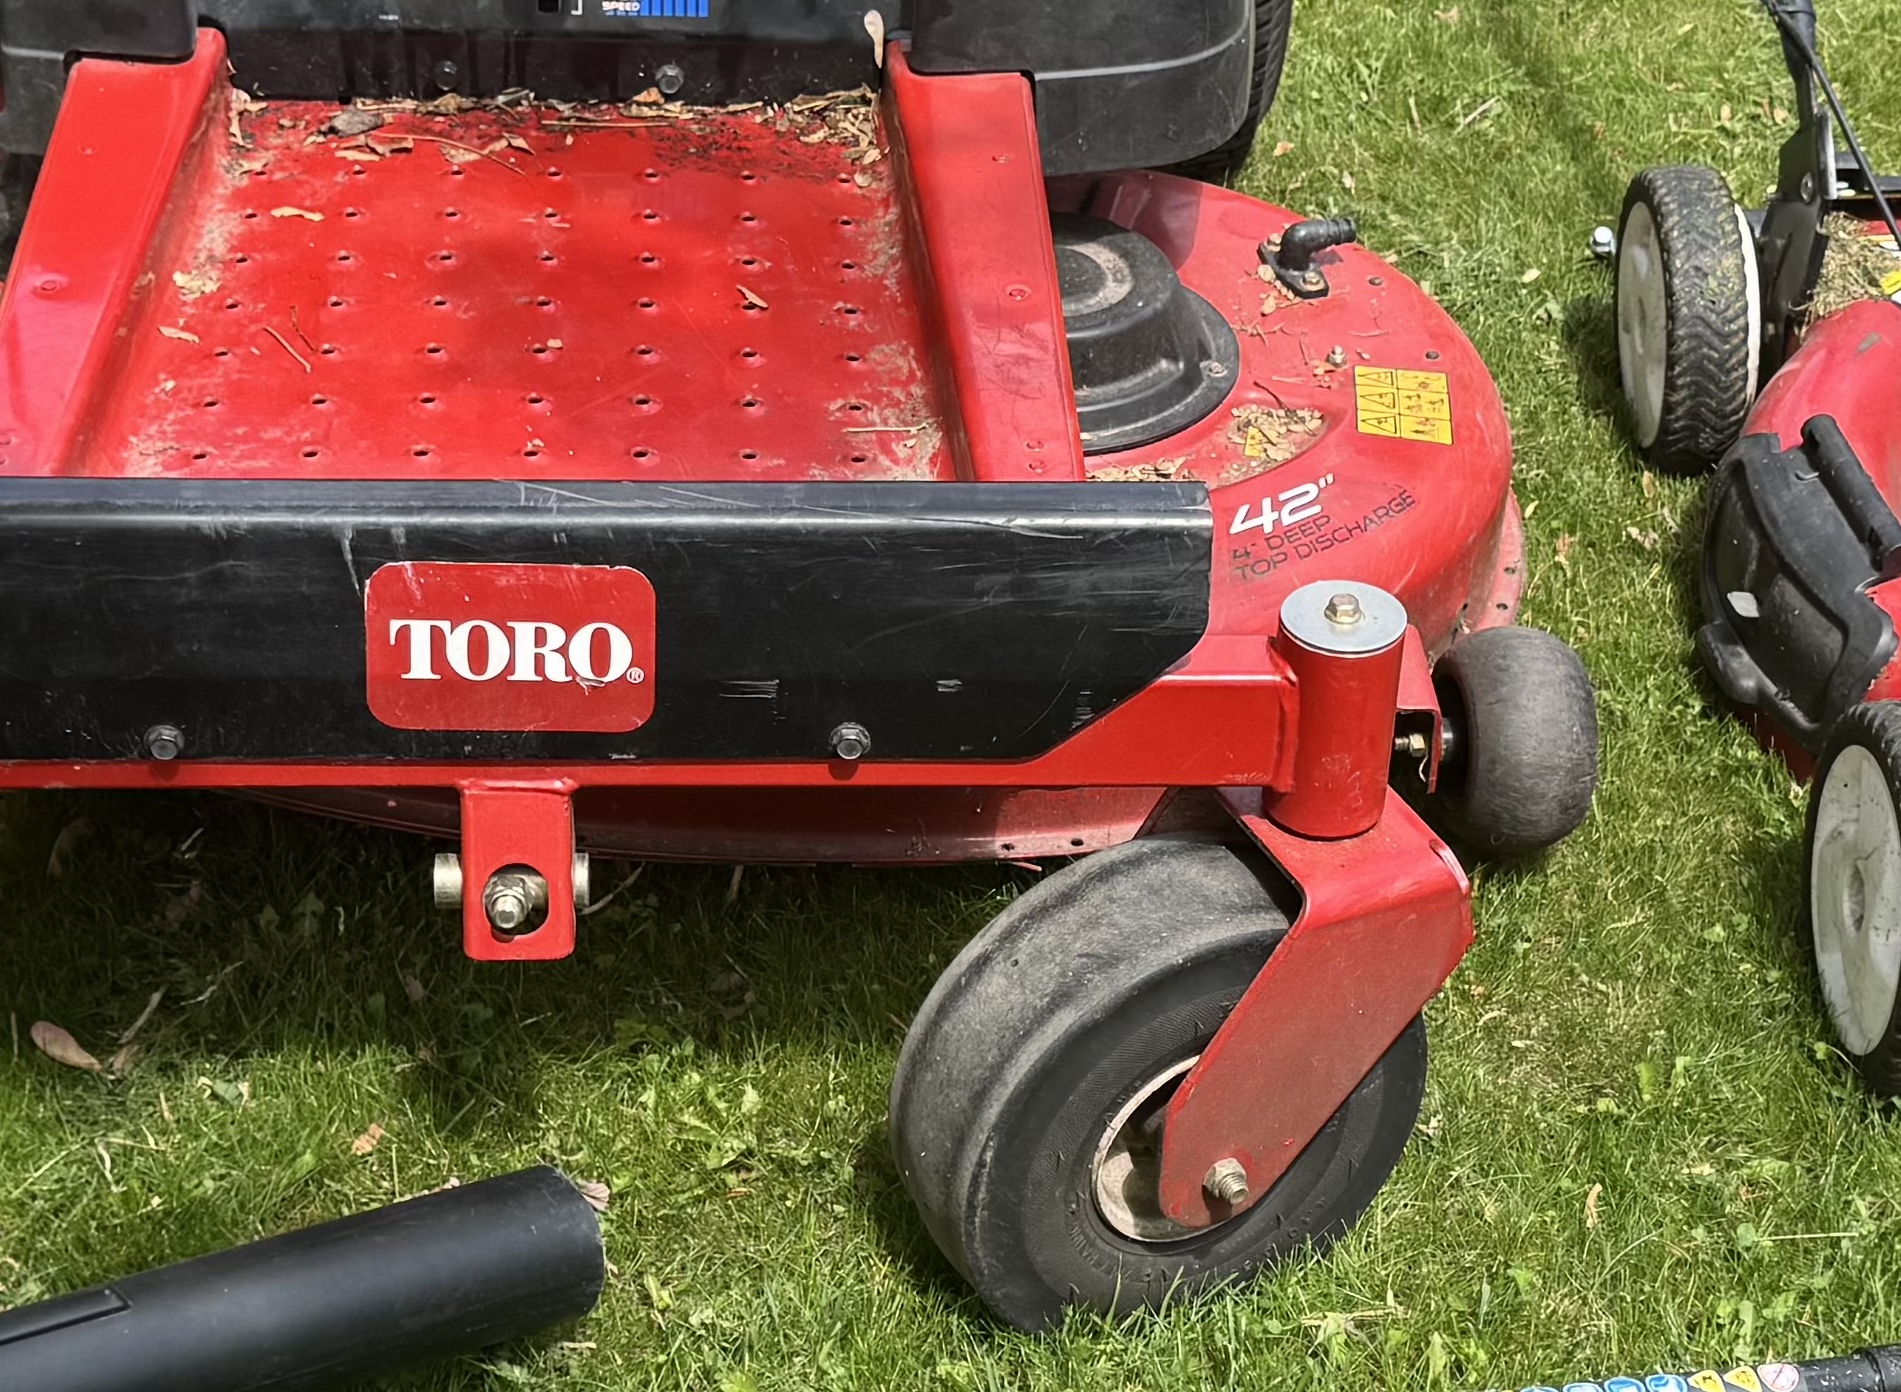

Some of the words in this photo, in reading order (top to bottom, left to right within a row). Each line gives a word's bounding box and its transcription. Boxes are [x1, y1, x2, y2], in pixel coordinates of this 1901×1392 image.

[601, 1, 641, 12] SPEED
[1234, 550, 1288, 581] TOP
[1293, 488, 1417, 561] DISCHARGE
[1264, 514, 1331, 551] DEEP
